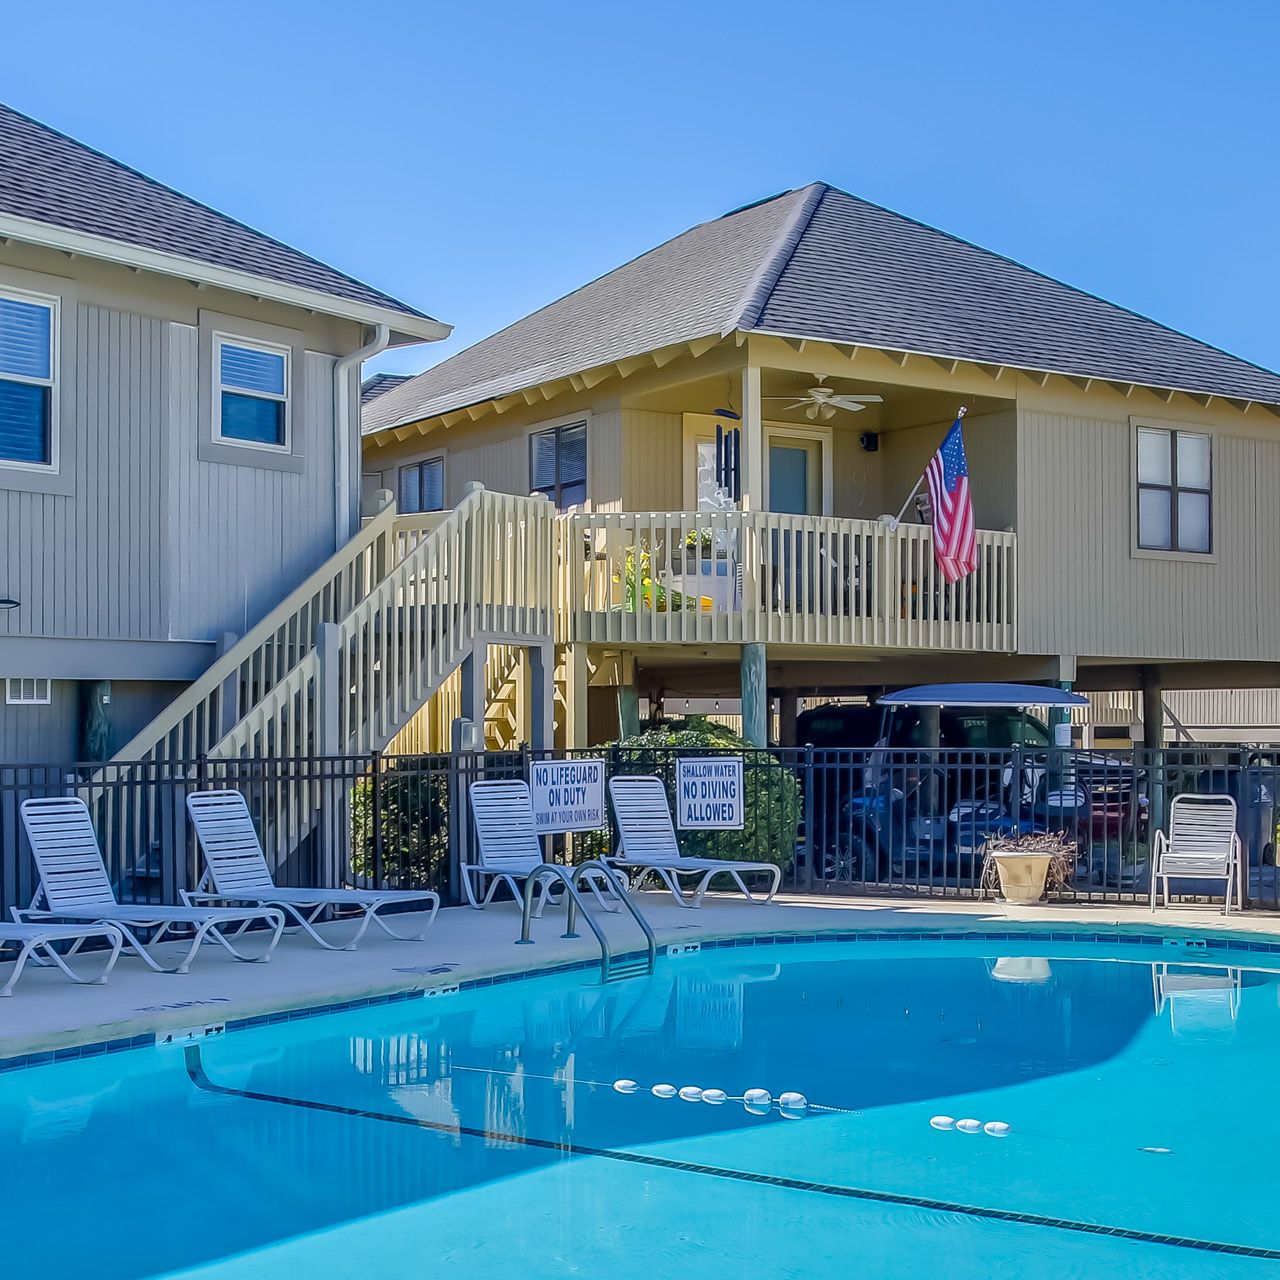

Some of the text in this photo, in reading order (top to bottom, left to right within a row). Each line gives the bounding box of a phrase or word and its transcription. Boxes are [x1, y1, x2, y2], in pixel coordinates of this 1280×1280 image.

[536, 766, 599, 786] NO LIFEGUARD
[682, 765, 736, 777] SHALLOW WATER
[548, 786, 587, 807] ON DUTY
[683, 780, 736, 799] NO DIVING
[536, 808, 600, 825] SWIM AT YOUR OWN RISK
[687, 803, 734, 822] ALLOWED
